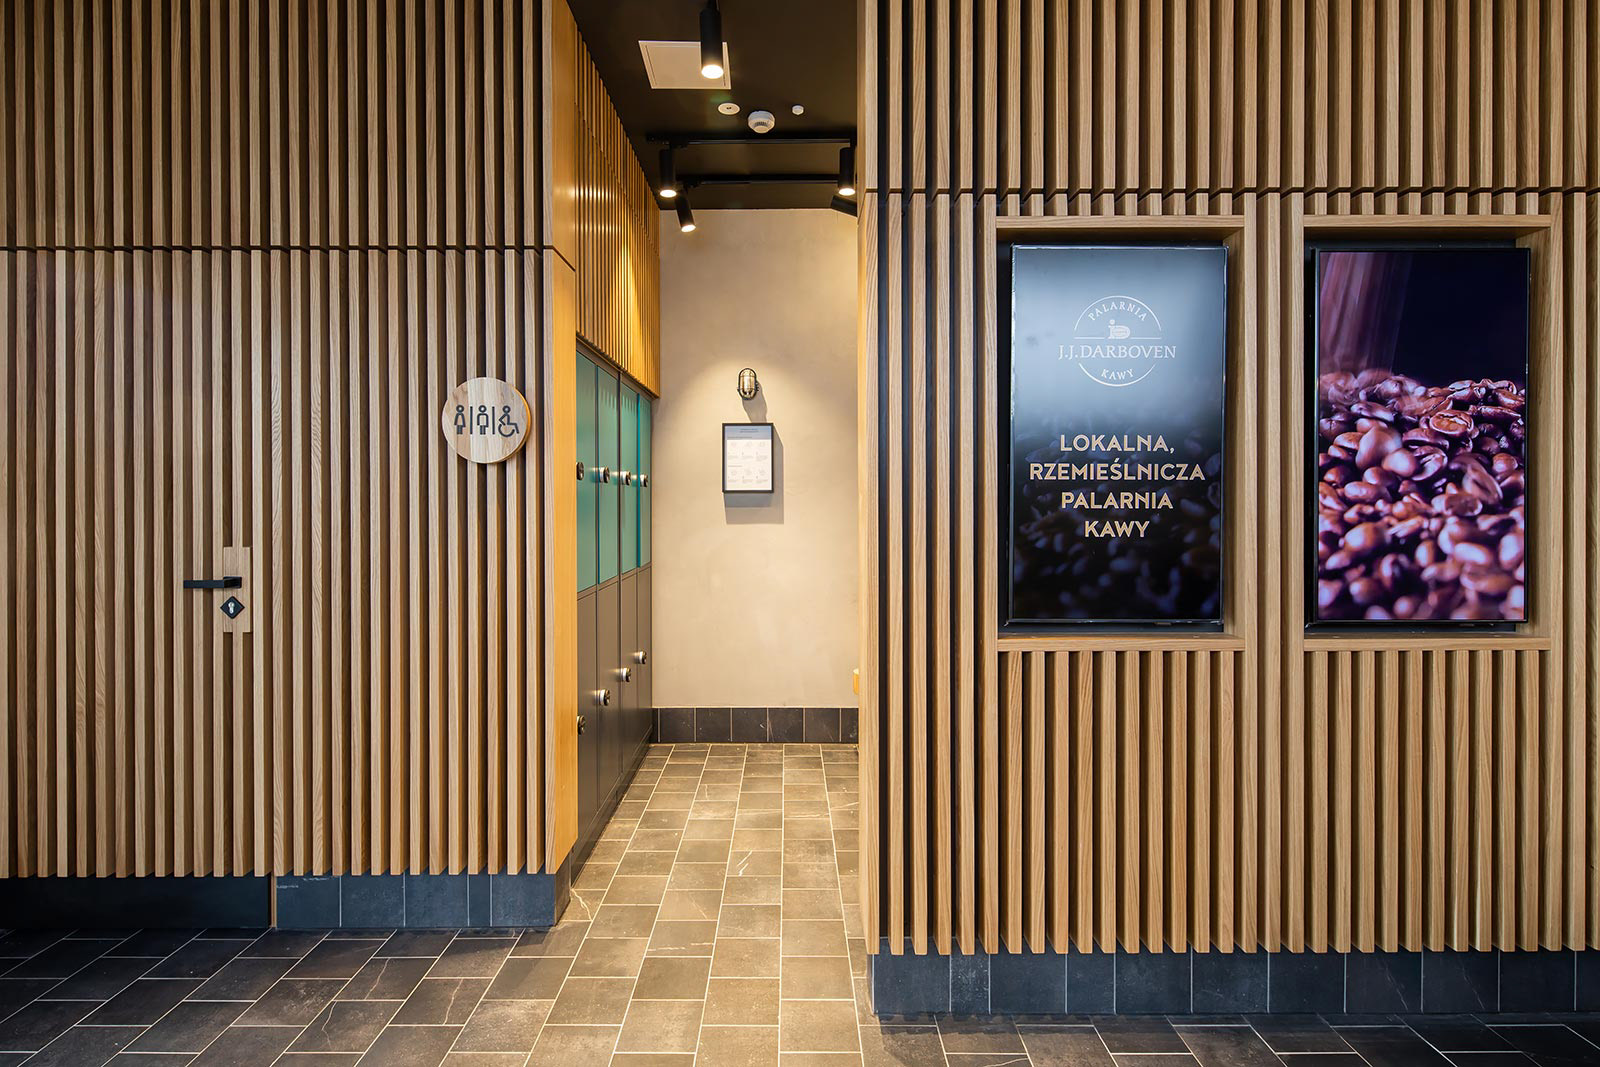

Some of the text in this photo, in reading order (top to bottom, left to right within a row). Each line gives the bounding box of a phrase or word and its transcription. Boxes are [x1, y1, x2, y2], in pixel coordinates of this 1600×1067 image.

[1088, 301, 1148, 321] PALARNIA
[1101, 368, 1134, 381] KAWY
[1060, 434, 1175, 454] LOKALNA,
[1029, 457, 1205, 481] RZEMIEŚLNICZA
[1061, 491, 1173, 510] PALARNIA
[1084, 520, 1150, 538] KAWY
